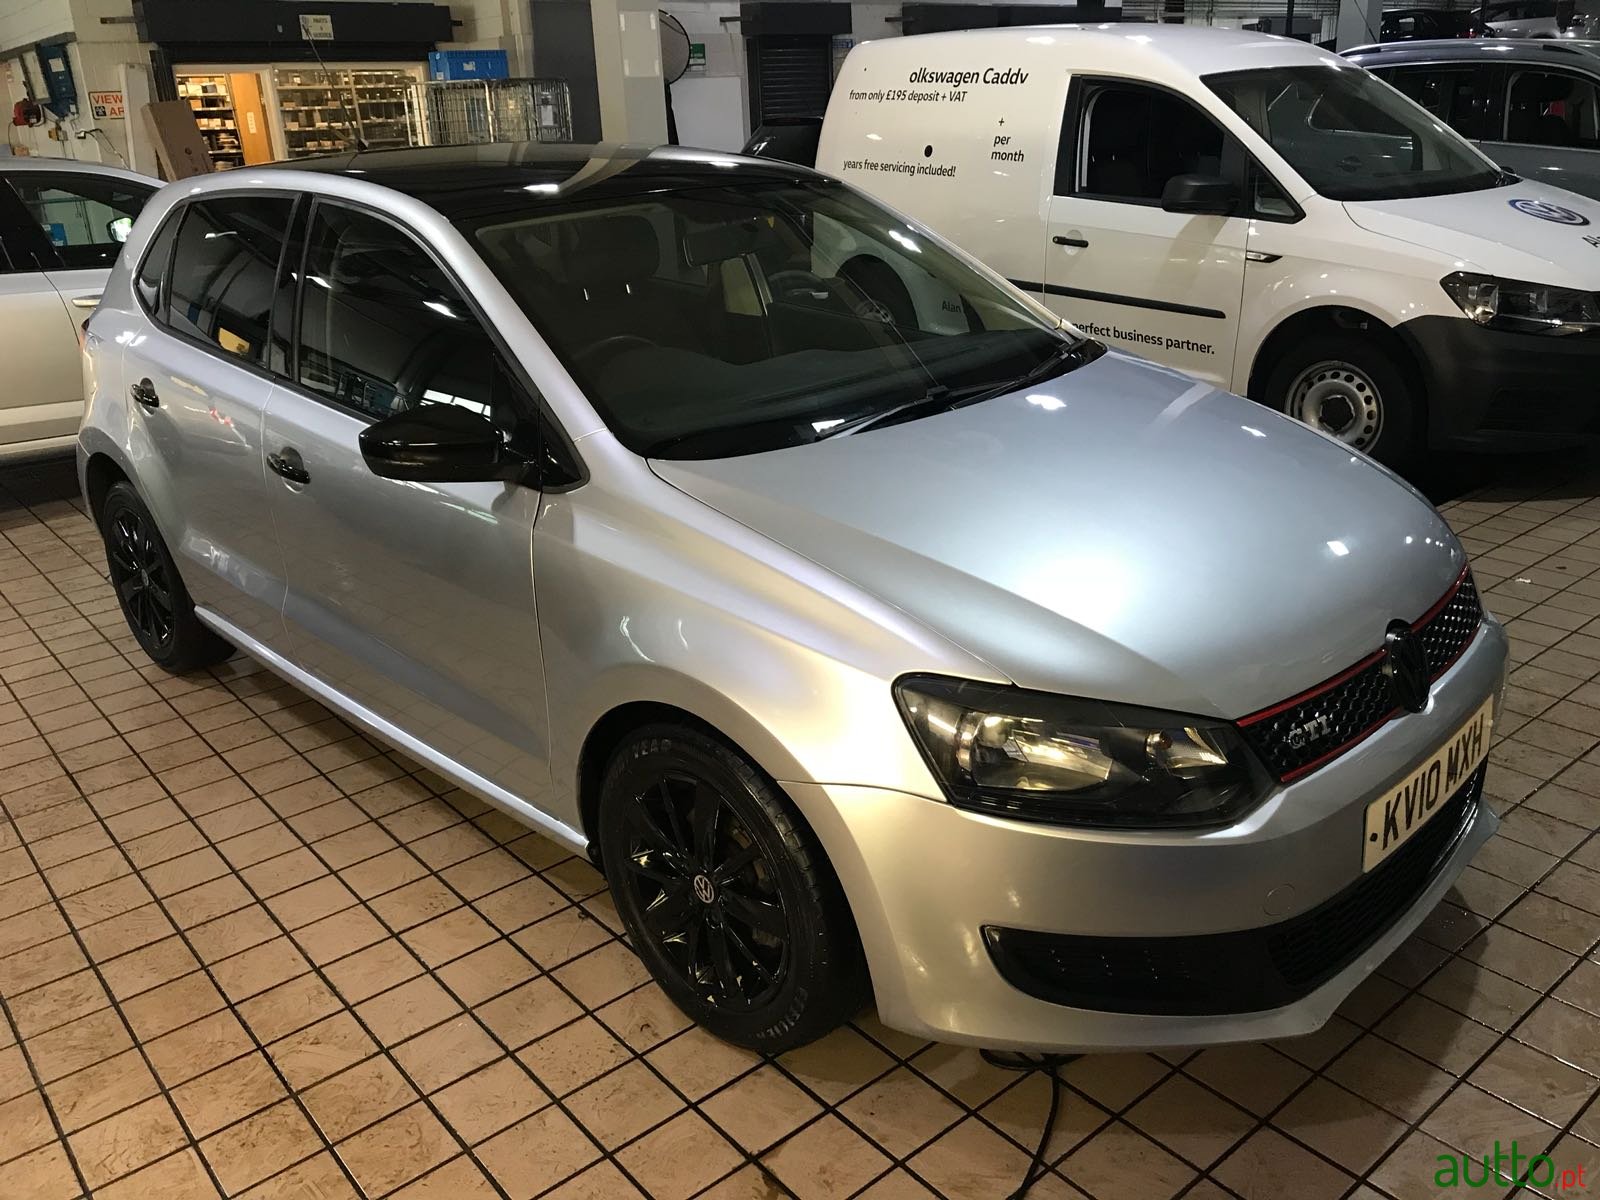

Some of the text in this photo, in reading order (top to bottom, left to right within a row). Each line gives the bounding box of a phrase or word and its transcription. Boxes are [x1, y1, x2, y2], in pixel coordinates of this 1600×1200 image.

[909, 67, 980, 87] olkswagen
[92, 94, 123, 104] VIEW
[849, 90, 867, 101] from
[868, 90, 884, 103] only
[886, 90, 907, 101] £195
[908, 90, 939, 103] deposit
[949, 91, 967, 102] VAT
[993, 134, 1011, 147] per
[991, 150, 1024, 162] month
[843, 159, 956, 177] years free servicing included!
[942, 300, 961, 312] Alan
[1114, 326, 1163, 345] business
[1166, 338, 1215, 354] partner.
[1445, 713, 1485, 794] MXH
